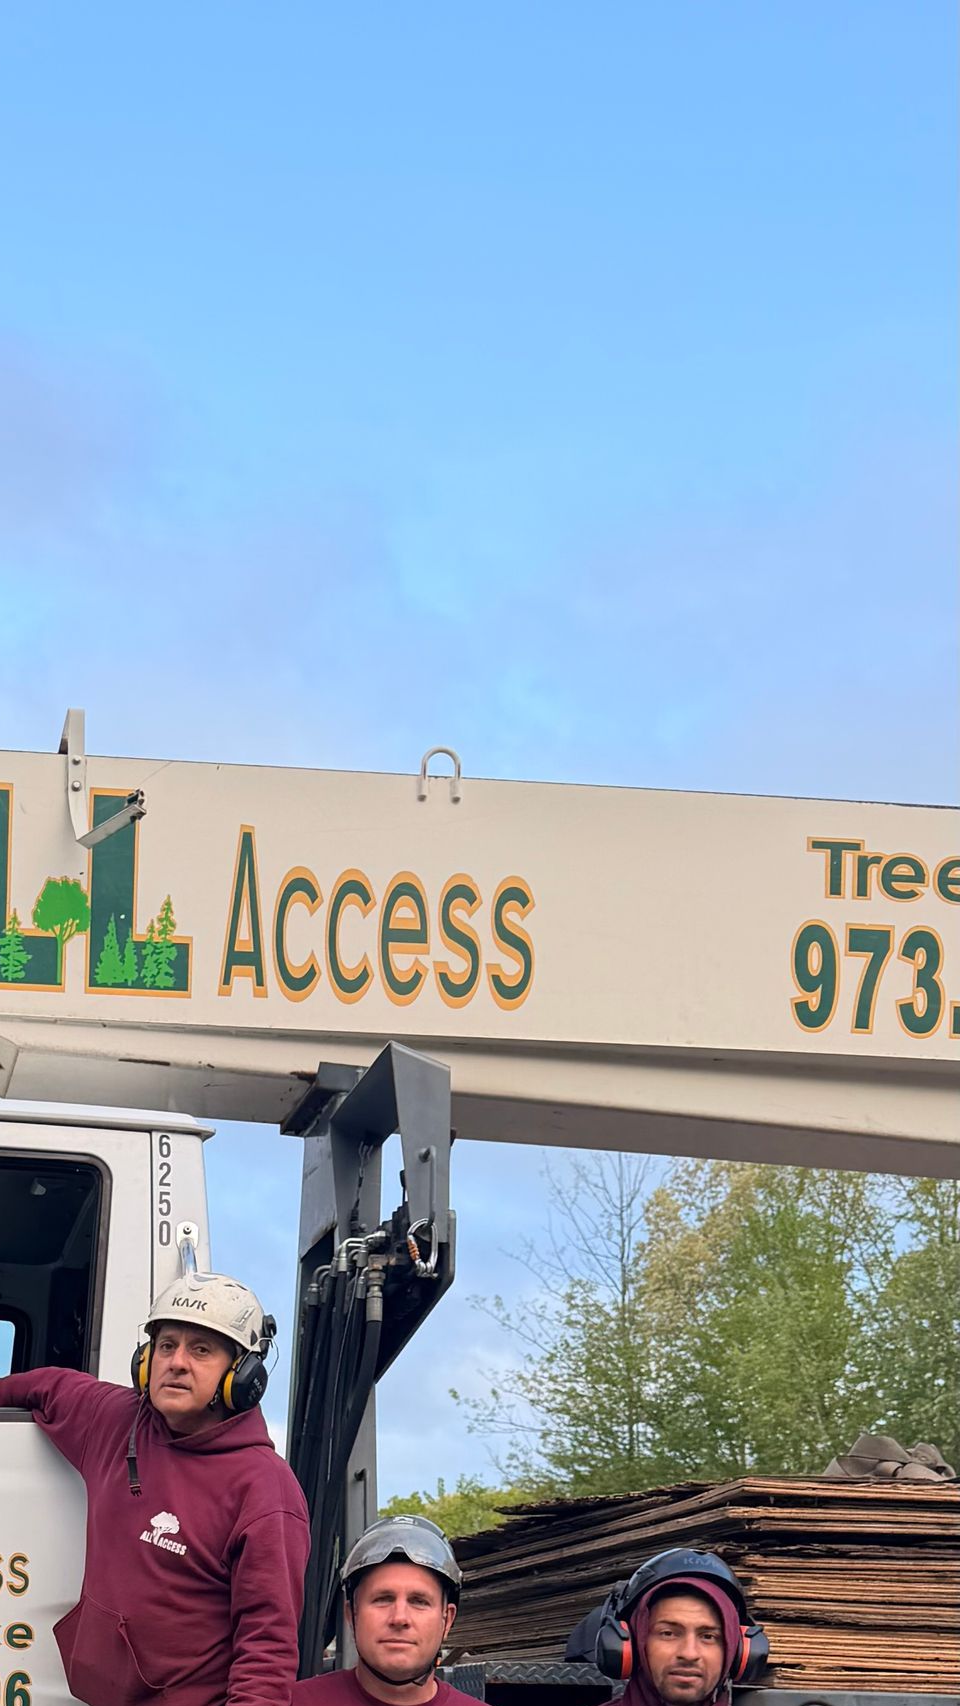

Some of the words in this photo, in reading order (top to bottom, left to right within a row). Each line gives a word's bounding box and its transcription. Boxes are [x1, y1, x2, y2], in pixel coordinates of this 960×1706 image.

[807, 836, 960, 905] Tree
[218, 824, 537, 1012] Access
[158, 1134, 172, 1247] 6250
[172, 1296, 208, 1312] KASK
[139, 1530, 152, 1544] ALL
[157, 1536, 188, 1556] ACCESS
